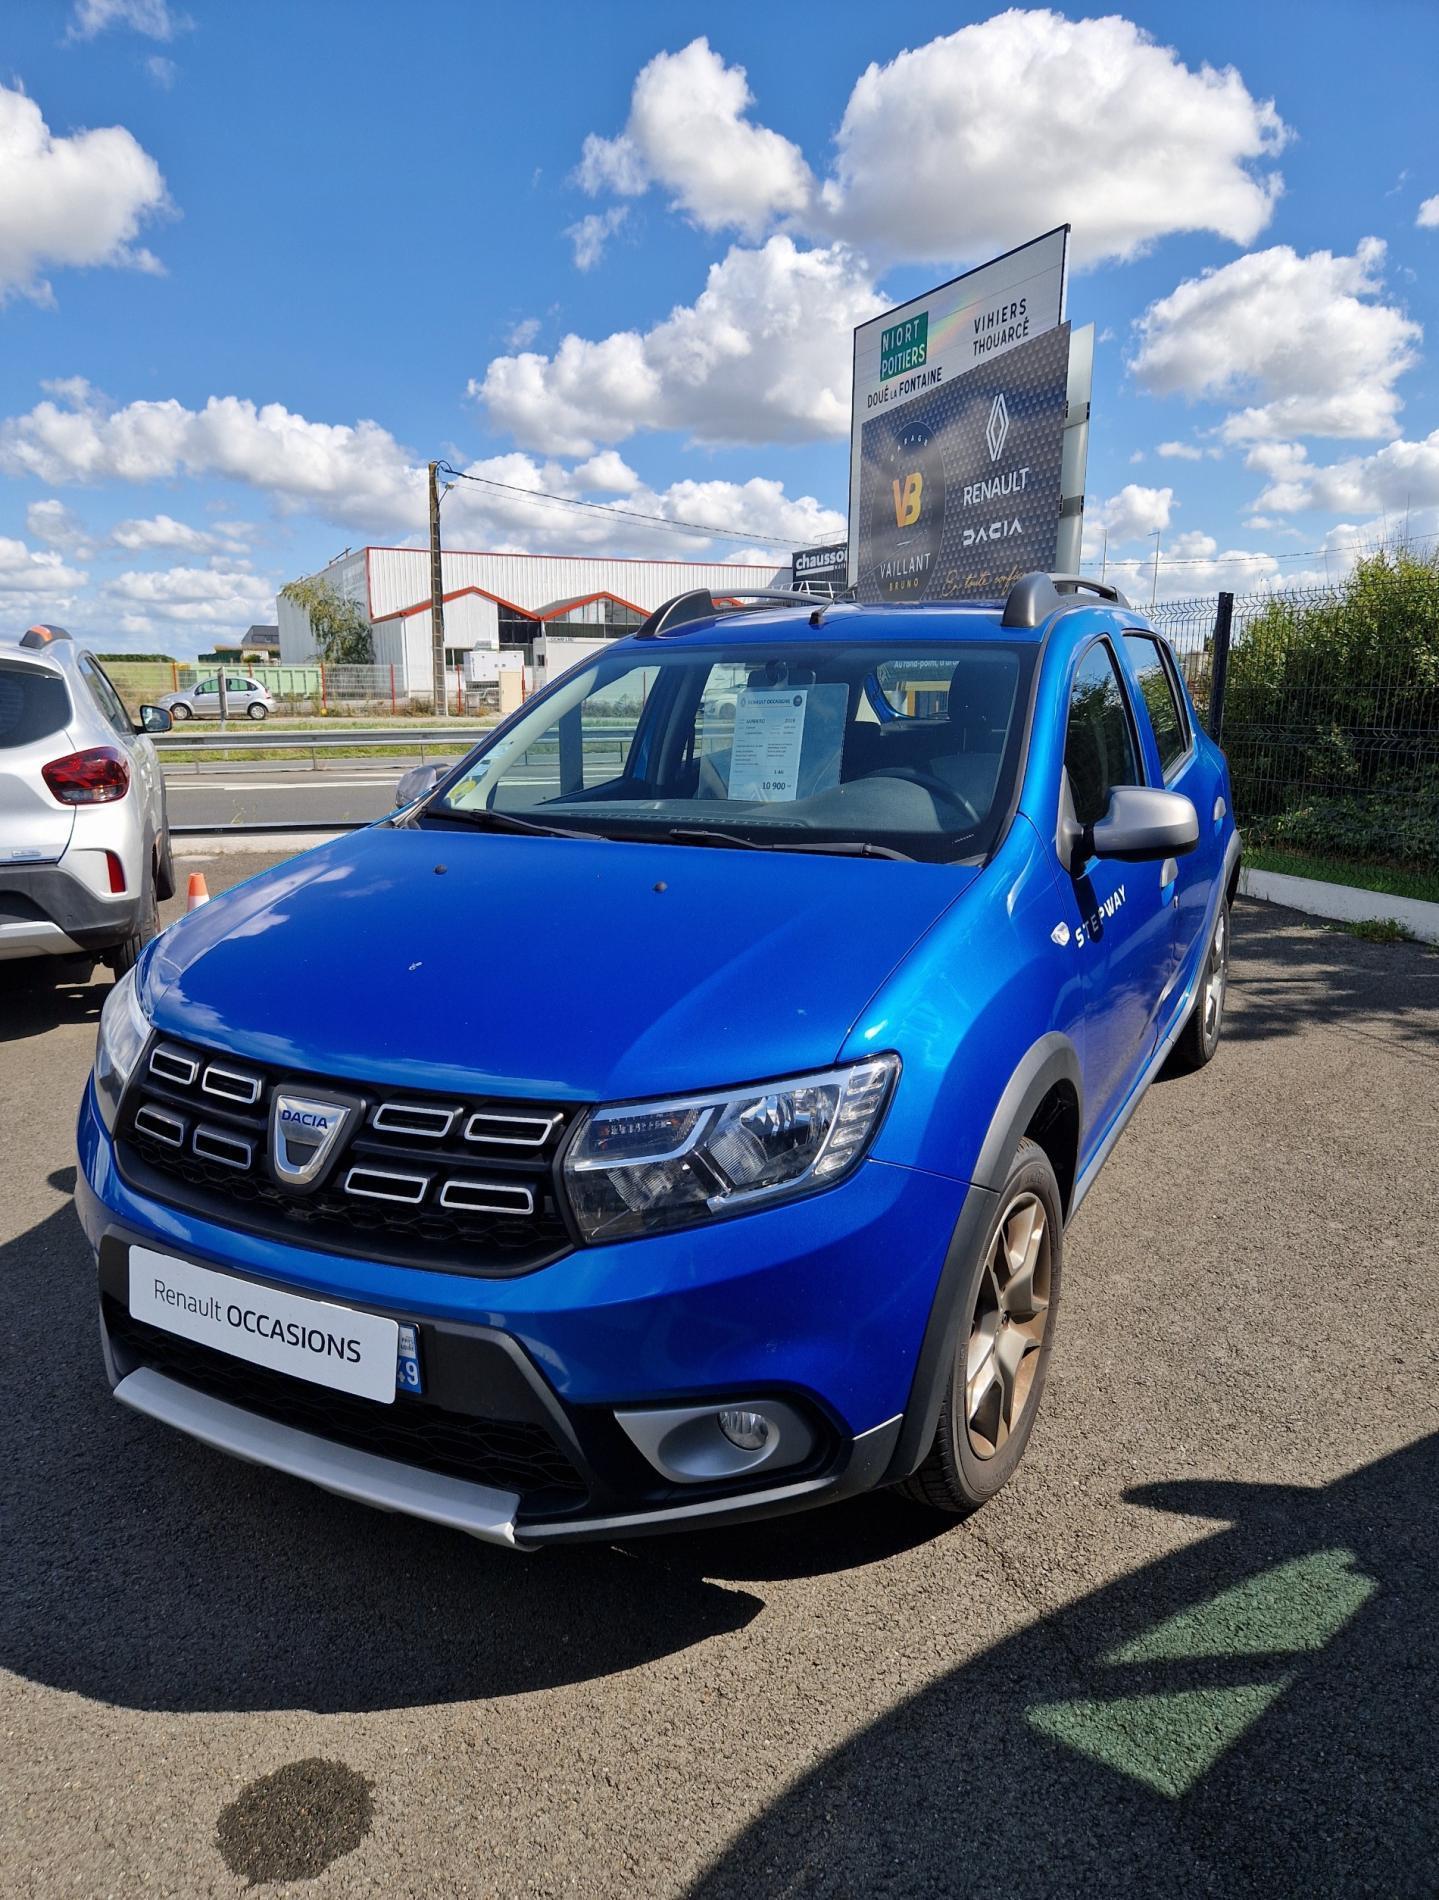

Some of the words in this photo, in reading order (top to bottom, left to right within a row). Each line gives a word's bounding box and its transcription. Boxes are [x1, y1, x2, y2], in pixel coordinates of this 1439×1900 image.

[974, 298, 1027, 335] VIHIERS
[882, 320, 920, 353] NIORT
[973, 316, 1030, 356] THOUARCÉ
[881, 343, 926, 379] POITIERS
[867, 385, 889, 409] DOUÉ
[890, 389, 897, 400] LA
[899, 366, 943, 397] FONTAINE
[893, 472, 923, 529] VB
[963, 466, 1030, 507] RENAULT
[963, 518, 1023, 546] DACIA
[880, 552, 931, 579] VAILLANT
[889, 578, 919, 592] BRUNO
[772, 781, 786, 790] 900
[1075, 884, 1126, 948] STEPWAY
[281, 1109, 328, 1129] DACIA
[154, 1278, 222, 1322] Renault
[226, 1304, 362, 1364] OCCASIONS
